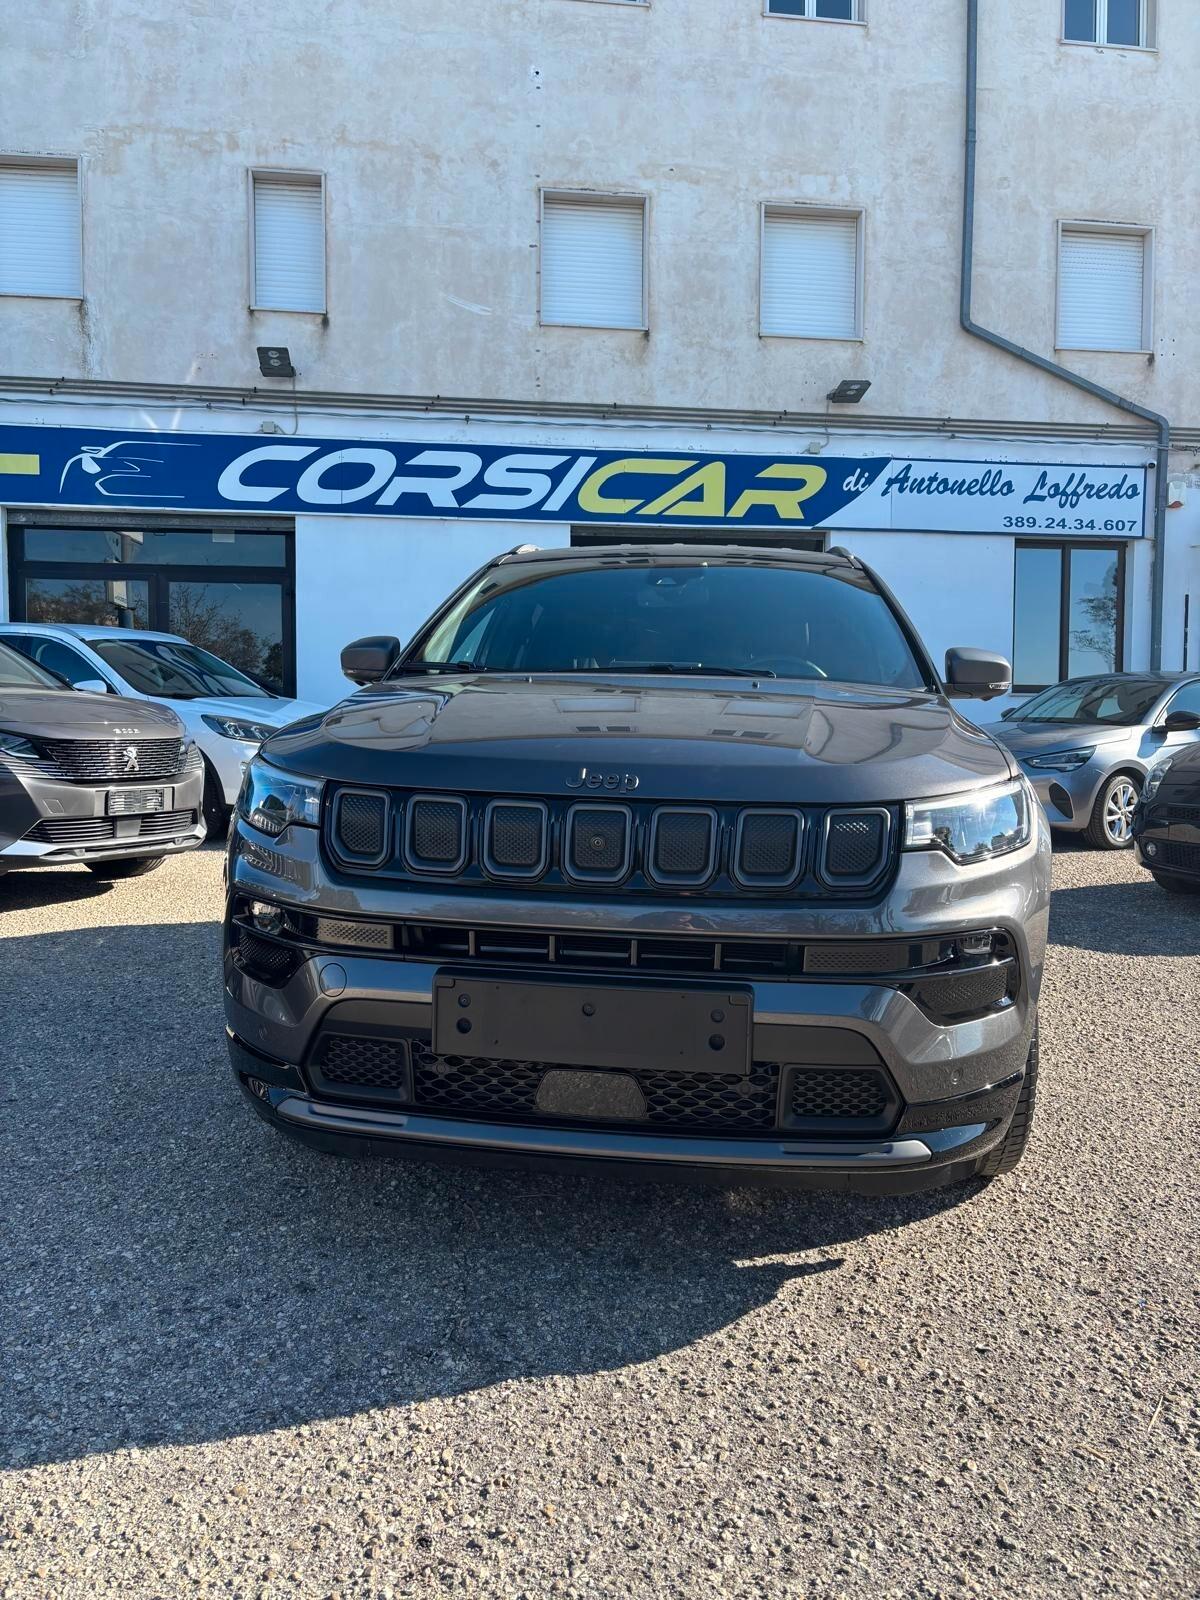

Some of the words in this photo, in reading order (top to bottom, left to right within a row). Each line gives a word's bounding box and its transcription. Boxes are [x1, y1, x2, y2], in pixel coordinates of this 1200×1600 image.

[217, 444, 828, 520] CORSICAR
[842, 467, 871, 492] di
[880, 463, 1016, 497] Antonello
[1022, 470, 1141, 509] Loffredo
[1002, 515, 1138, 532] 389.24.34.607
[565, 767, 640, 793] Jeep
